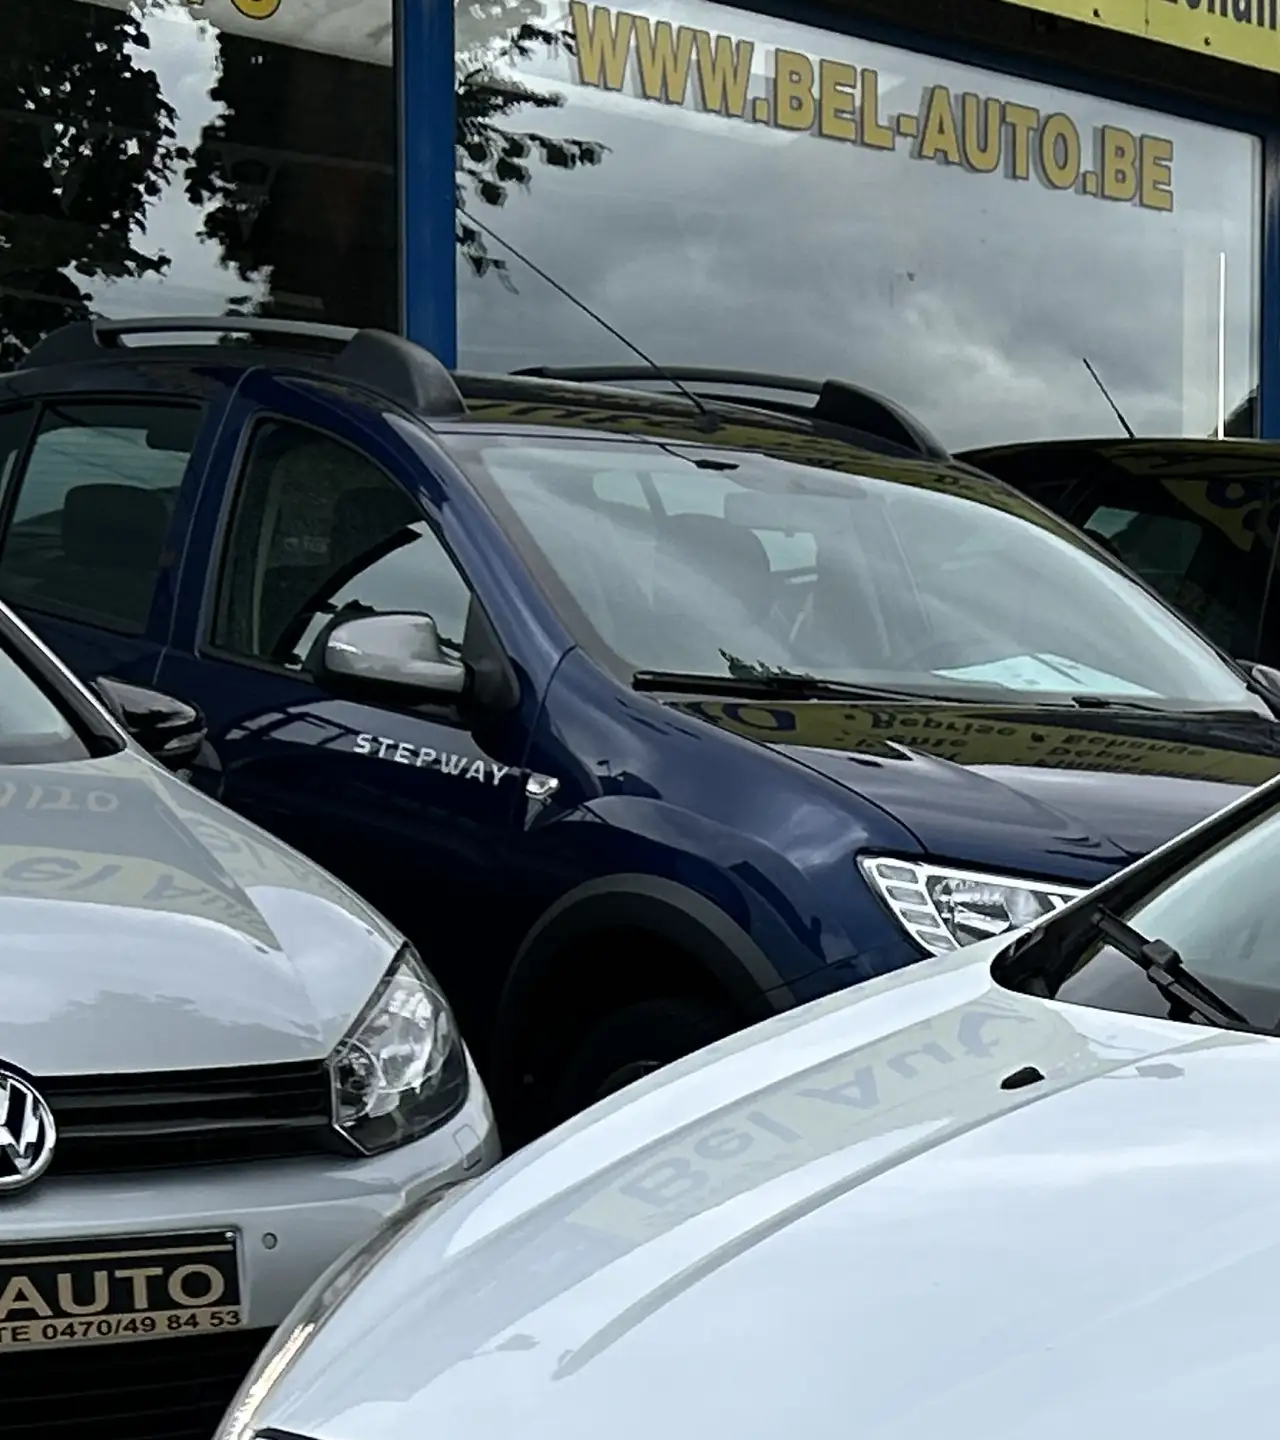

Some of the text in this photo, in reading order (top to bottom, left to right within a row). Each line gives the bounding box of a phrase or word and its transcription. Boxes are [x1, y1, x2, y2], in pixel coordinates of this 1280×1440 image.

[568, 0, 1174, 212] WWW.BEL-AUTO.BE
[353, 733, 511, 786] STEPWAY
[0, 1263, 226, 1320] AUTO
[42, 1316, 157, 1341] 0470/49
[167, 1314, 200, 1331] 84
[209, 1311, 241, 1327] 53
